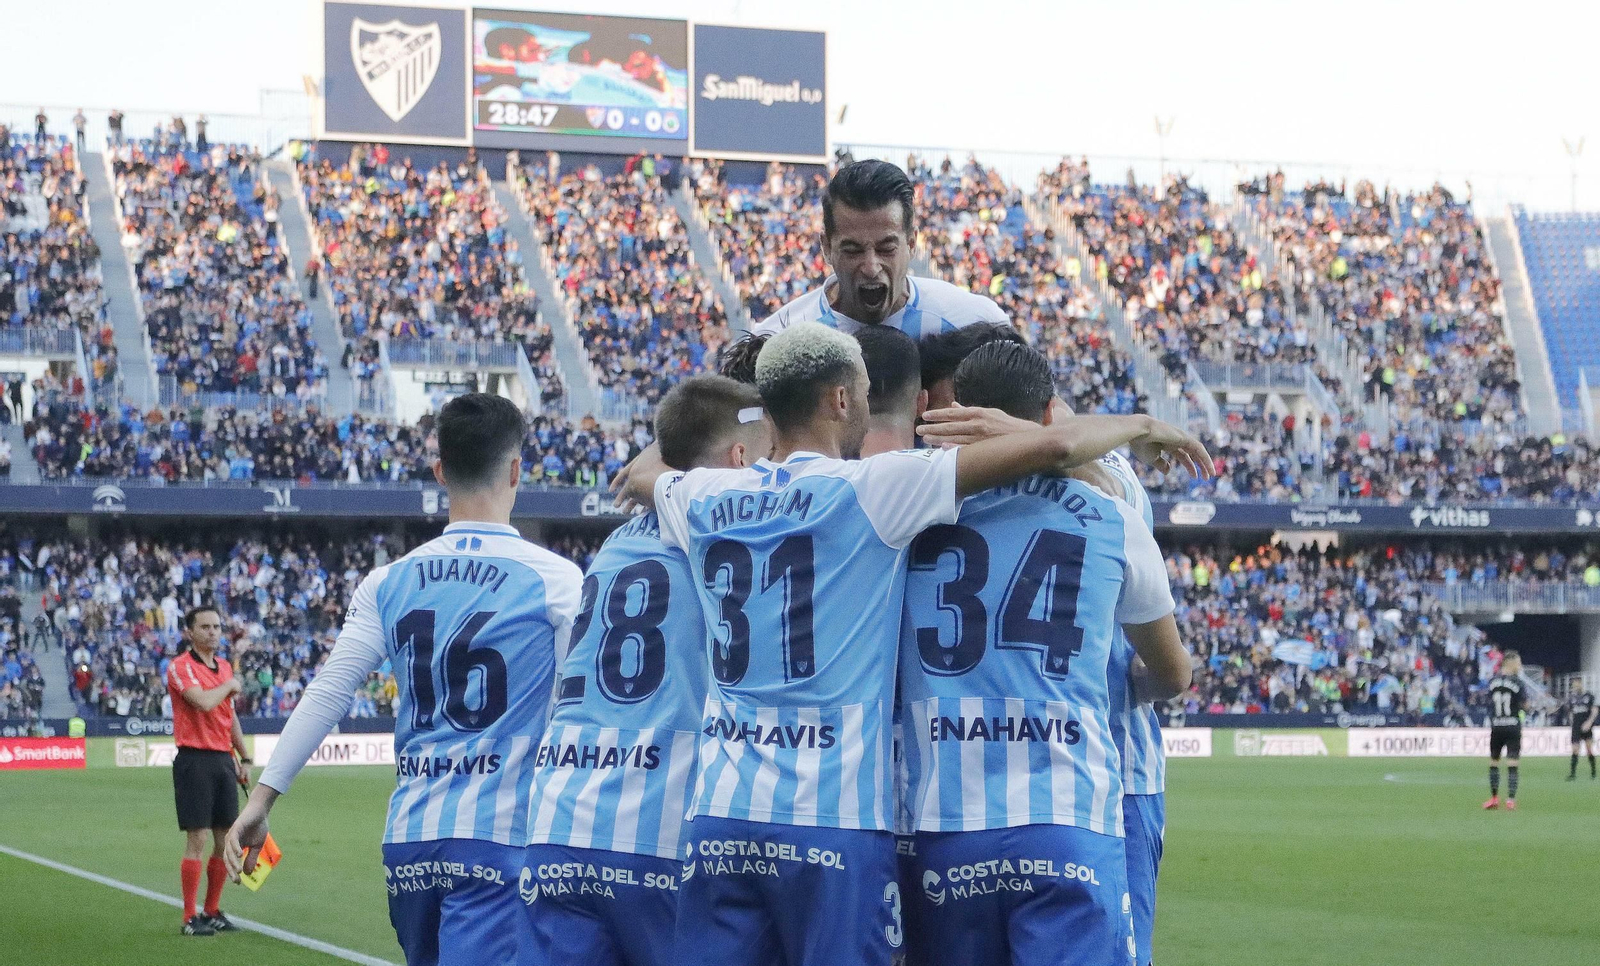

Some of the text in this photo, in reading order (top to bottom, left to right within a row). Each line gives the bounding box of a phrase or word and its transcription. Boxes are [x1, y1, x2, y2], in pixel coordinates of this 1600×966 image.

[488, 103, 559, 127] 28:47
[606, 108, 624, 130] 0
[645, 110, 662, 132] 0
[709, 488, 814, 533] HICHAM
[1429, 505, 1491, 527] vithas
[415, 558, 509, 594] JUANPI
[702, 536, 816, 687] 31
[908, 524, 1087, 680] 34
[391, 609, 508, 732] 16
[1492, 691, 1512, 716] 11
[13, 745, 85, 761] SmartBank
[396, 754, 501, 778] ENAHAVIS
[699, 840, 845, 870] COSTA DEL SOL
[702, 856, 780, 878] MÁLAGA
[395, 861, 505, 886] COSTA DEL SOL
[537, 862, 679, 891] COSTA DEL SOL
[947, 858, 1100, 886] COSTA DEL SOL
[951, 878, 1035, 900] MÁLAGA
